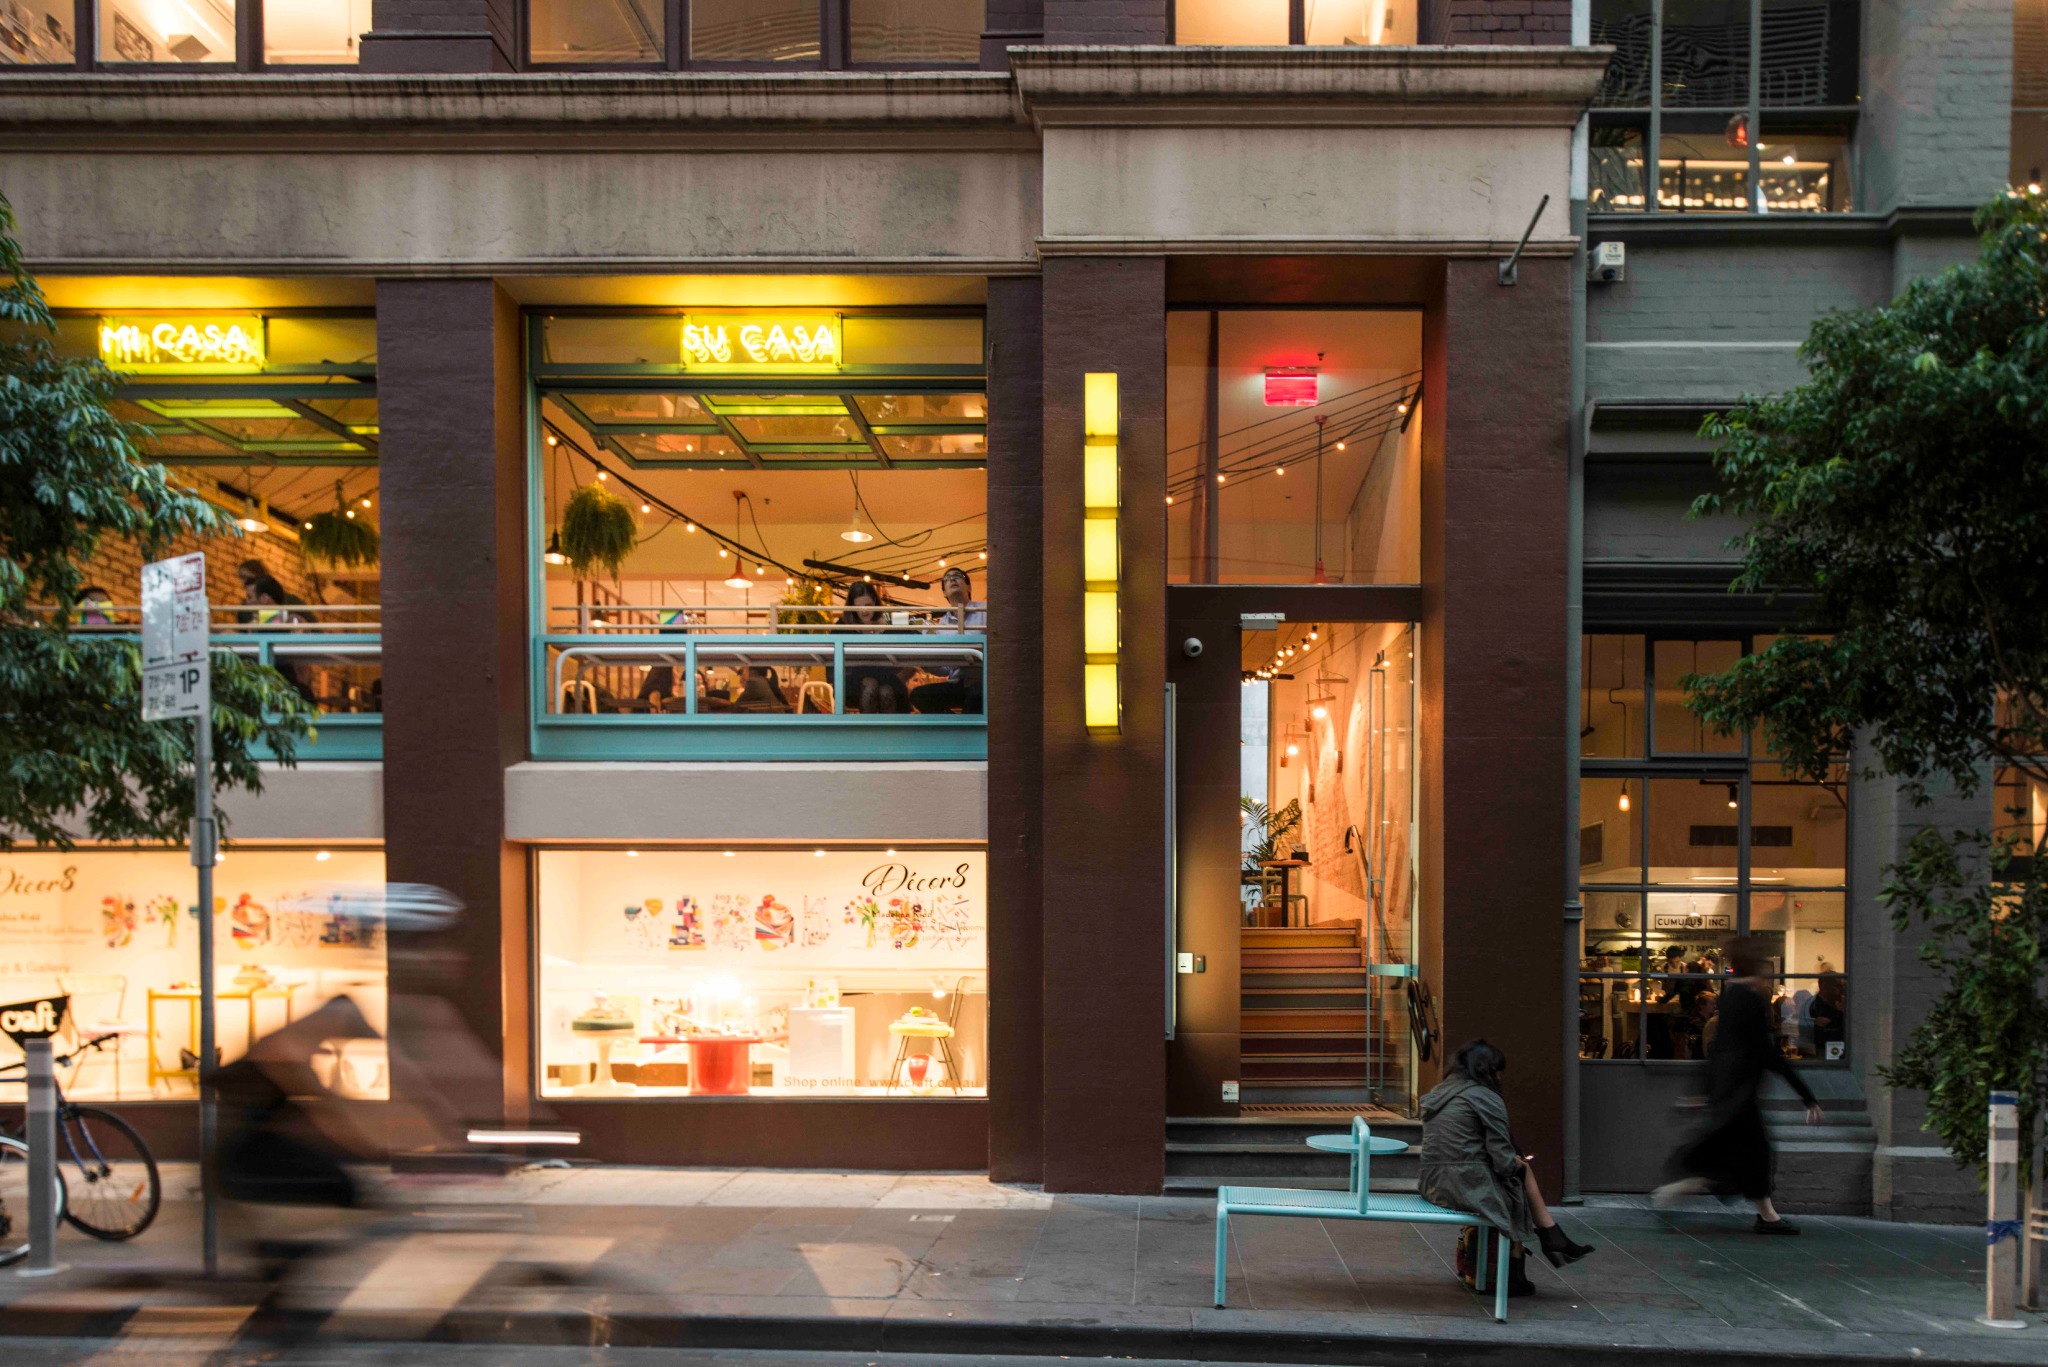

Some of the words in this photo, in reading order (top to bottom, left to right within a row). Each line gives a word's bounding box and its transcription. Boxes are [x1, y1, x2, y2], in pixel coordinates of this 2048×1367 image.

[101, 324, 140, 353] MI
[152, 323, 249, 352] CASA
[682, 324, 725, 351] SU
[740, 324, 835, 351] CASA
[180, 669, 200, 694] 1P
[1657, 918, 1702, 927] CUMULUS
[1708, 919, 1727, 927] INC.
[783, 1076, 818, 1089] Shop
[821, 1076, 861, 1088] online
